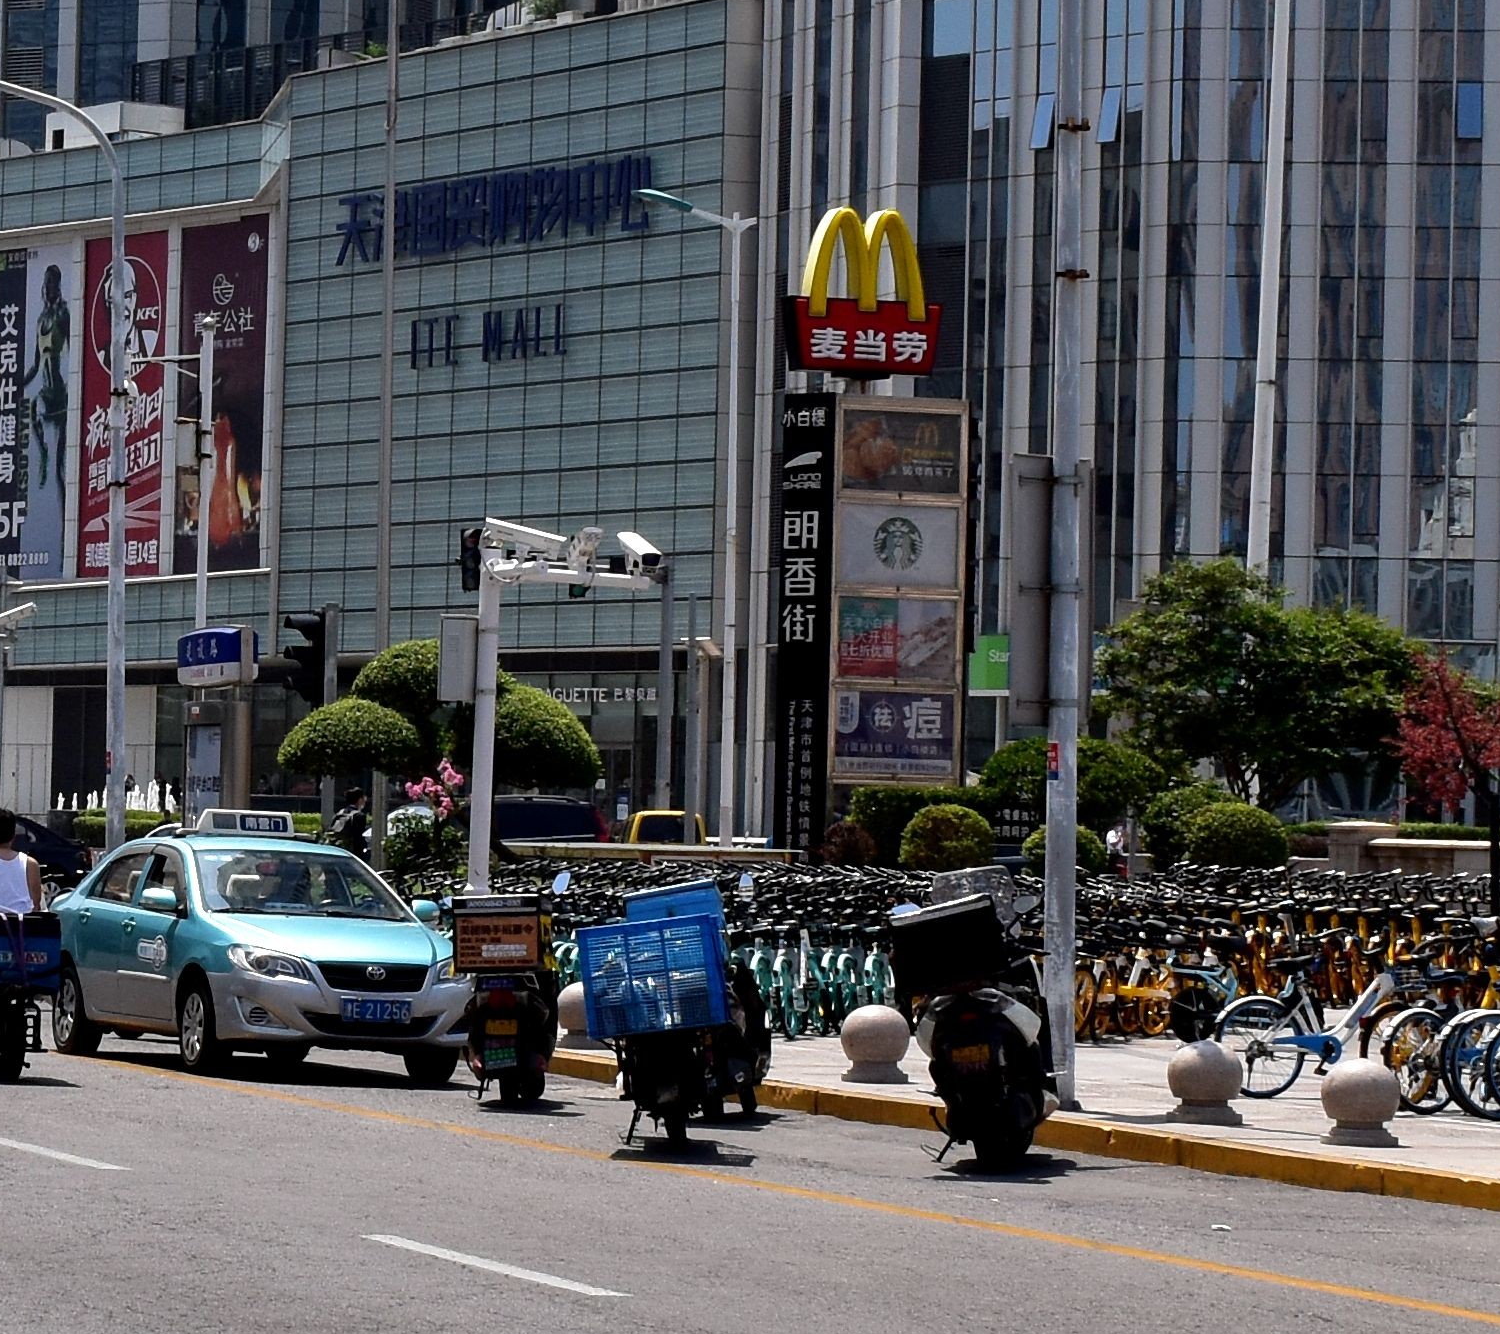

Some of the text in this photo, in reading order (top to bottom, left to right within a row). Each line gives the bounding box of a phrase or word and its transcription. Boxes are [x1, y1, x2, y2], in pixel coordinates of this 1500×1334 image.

[335, 154, 652, 267] 天津国贸购物中心
[136, 304, 160, 322] KFC
[192, 306, 255, 338] 青年公社
[482, 303, 567, 363] MALL
[810, 326, 928, 364] 麦当劳
[782, 407, 826, 428] 小白楼
[782, 510, 819, 643] 朗香街
[537, 687, 608, 703] AGUETTE
[903, 697, 943, 740] 痘
